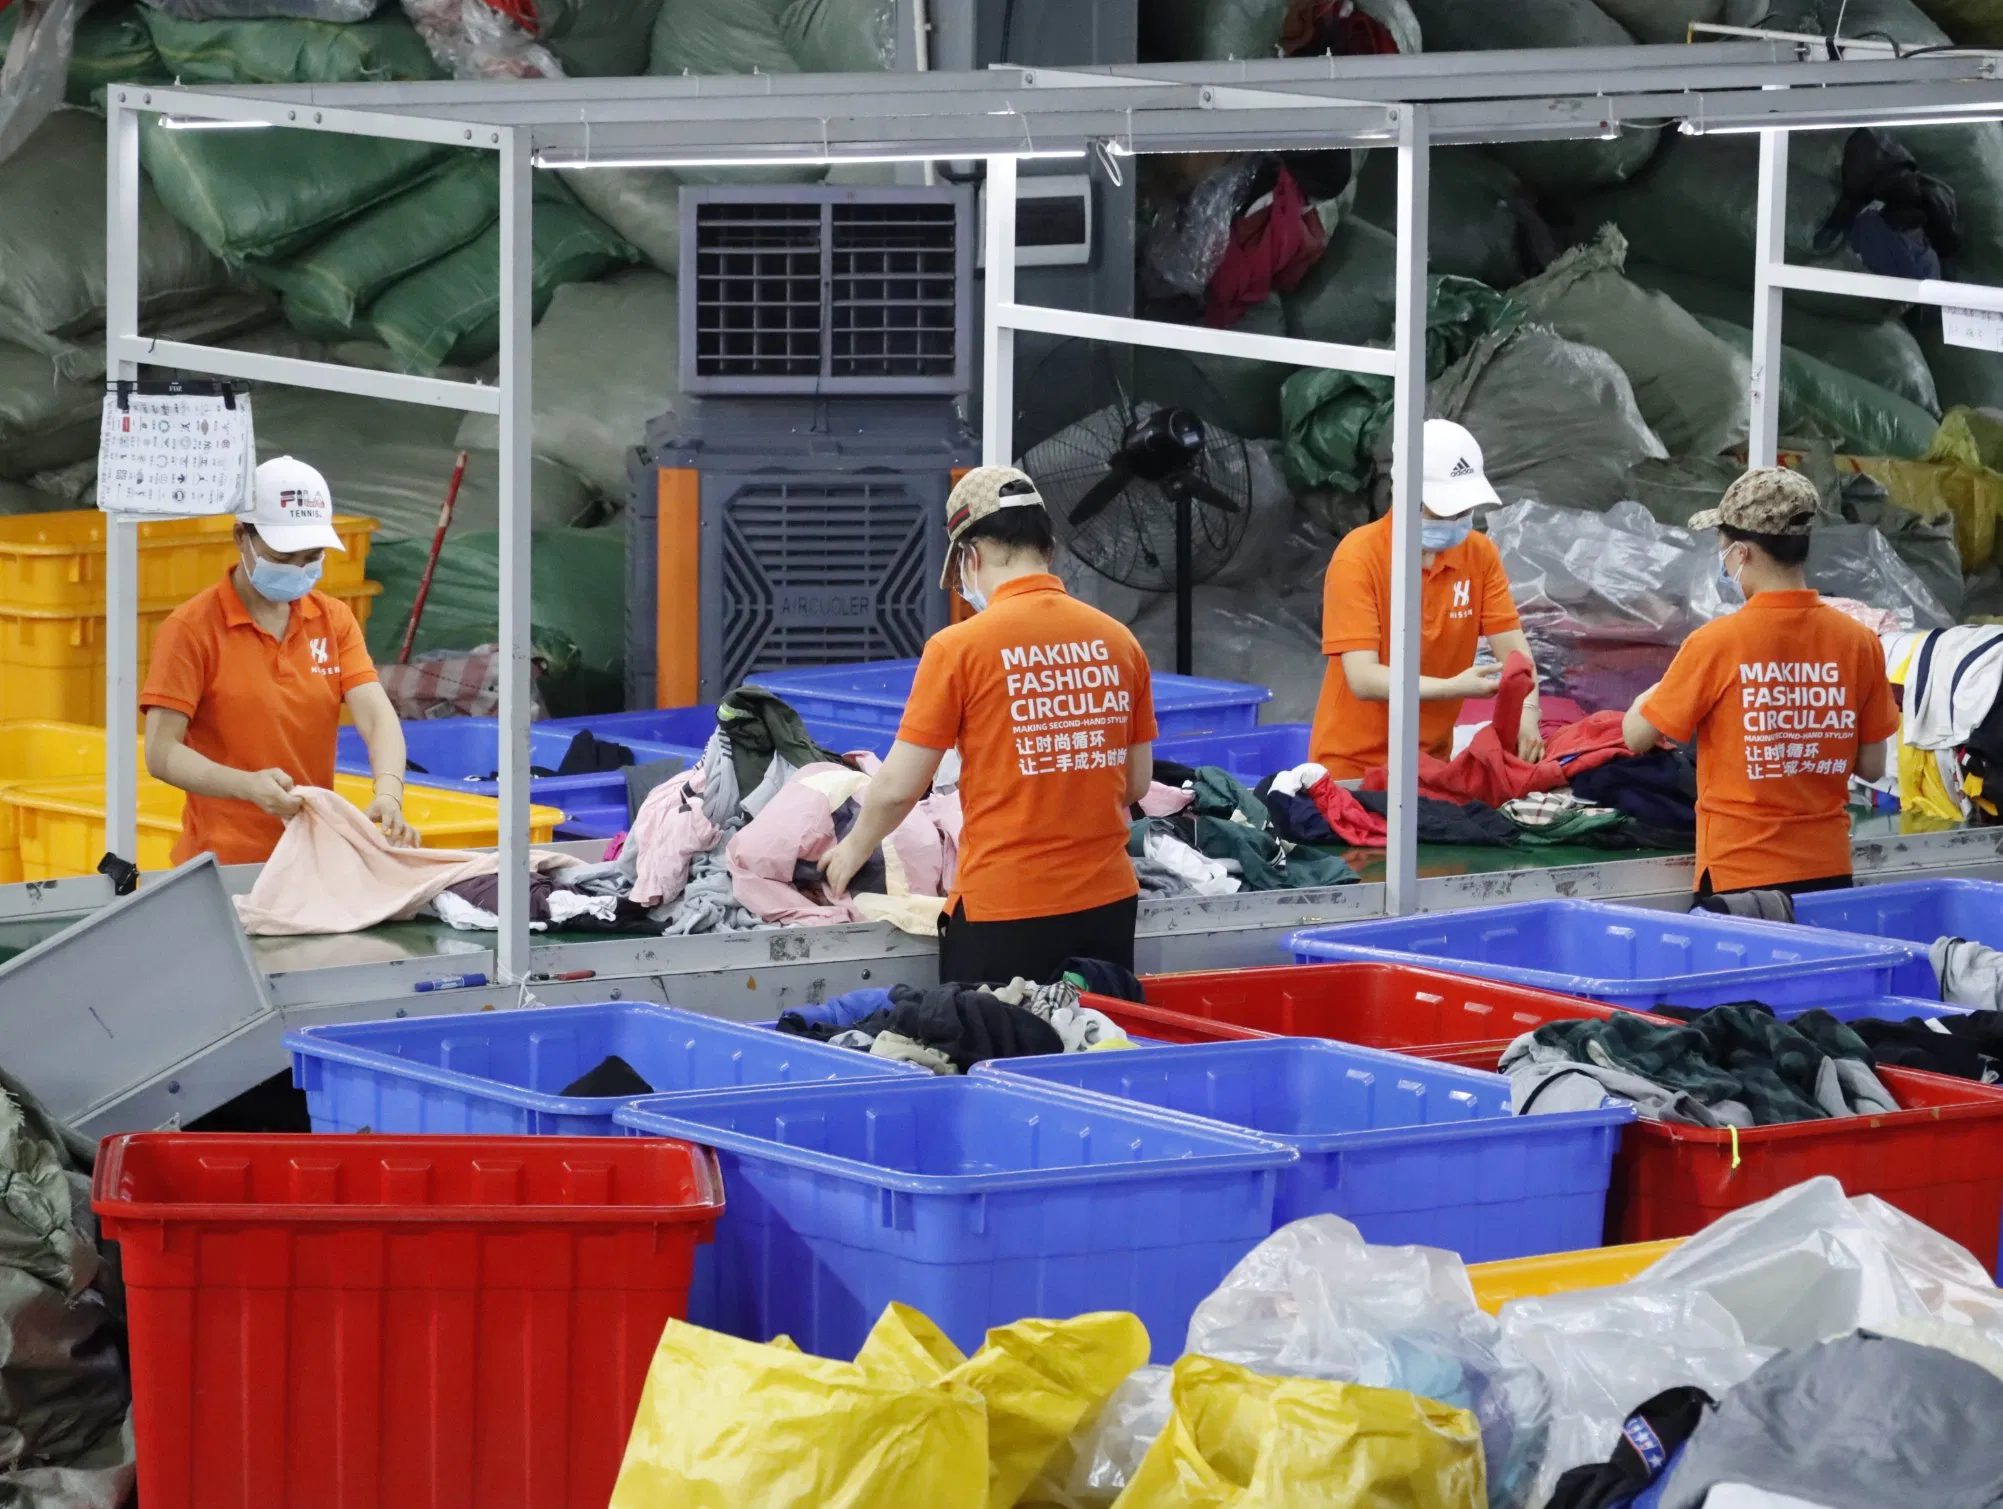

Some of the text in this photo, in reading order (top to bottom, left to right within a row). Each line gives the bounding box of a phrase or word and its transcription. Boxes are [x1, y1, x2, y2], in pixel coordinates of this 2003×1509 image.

[280, 489, 325, 508] FILA
[1000, 639, 1109, 670] MAKING
[1006, 665, 1120, 697] FASHION
[1740, 662, 1839, 684] MAKING
[1010, 691, 1130, 722] CIRCULAR
[1742, 686, 1846, 708] FASHION
[1012, 723, 1048, 734] MAKING
[1049, 717, 1106, 730] SECOND-HAND
[1743, 710, 1856, 732] CIRCULAR
[1016, 729, 1106, 755] 让时尚循环
[1019, 747, 1127, 775] 让二手成为时尚
